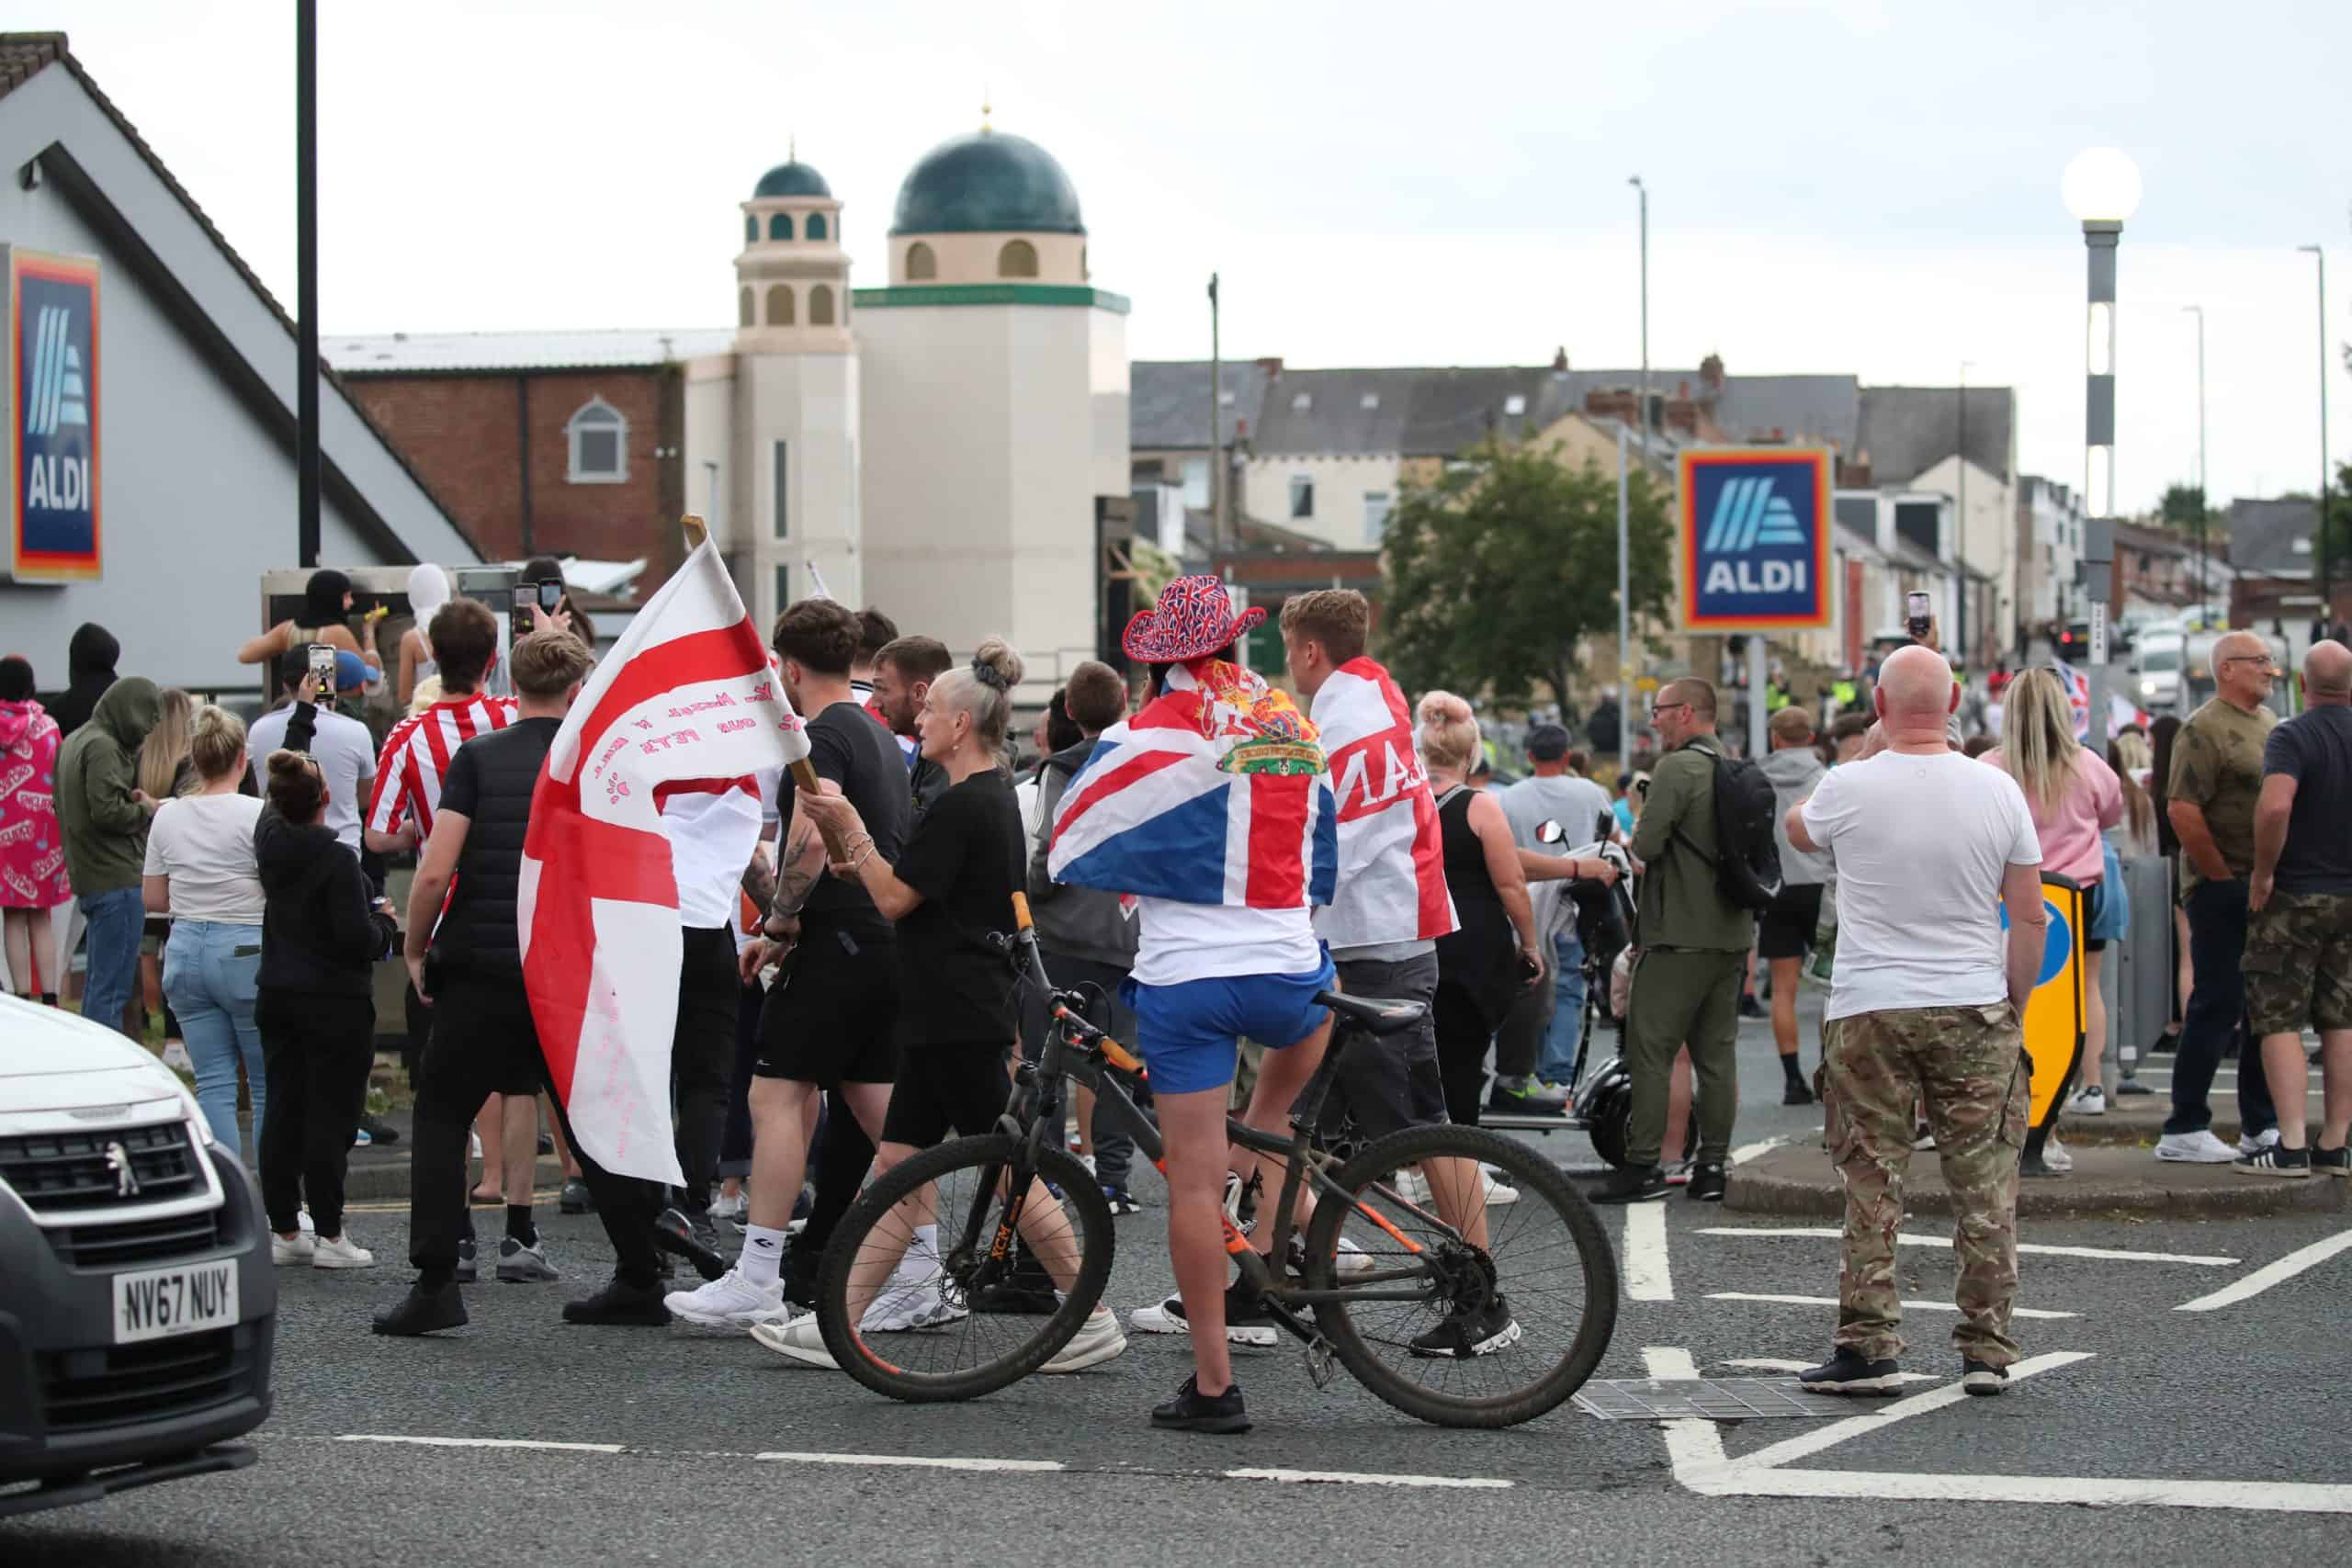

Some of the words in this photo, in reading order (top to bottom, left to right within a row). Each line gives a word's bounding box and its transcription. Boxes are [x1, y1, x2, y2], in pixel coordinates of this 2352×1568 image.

[28, 454, 89, 512] ALDI
[1704, 559, 1806, 594] ALDI
[125, 1274, 184, 1331] NV67
[190, 1267, 229, 1321] NUY
